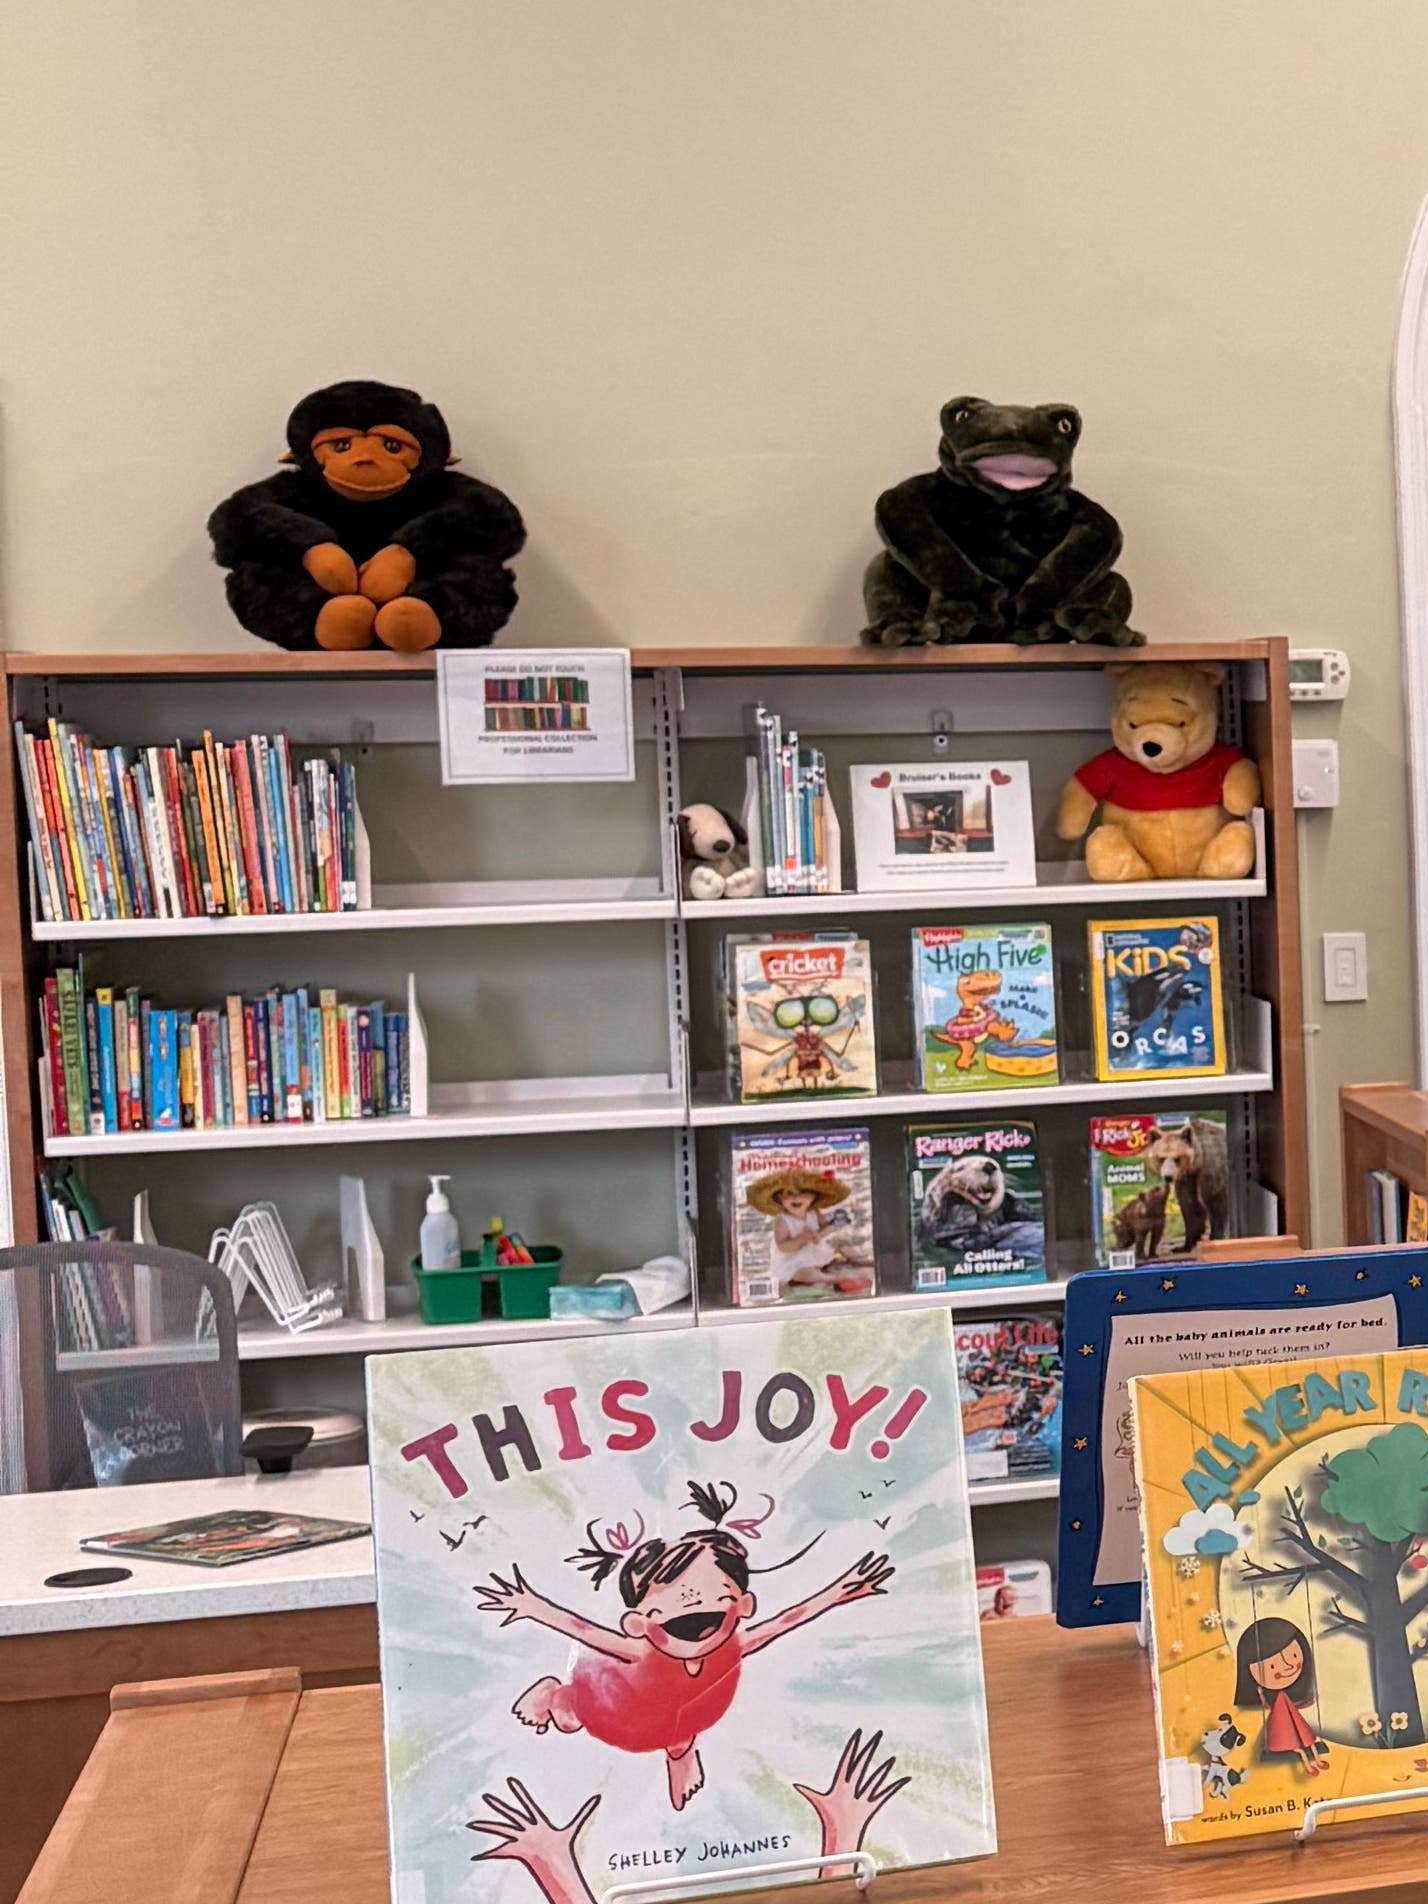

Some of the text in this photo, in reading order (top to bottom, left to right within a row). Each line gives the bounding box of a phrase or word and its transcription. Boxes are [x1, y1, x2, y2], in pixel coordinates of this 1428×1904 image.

[767, 953, 837, 973] cricket
[925, 940, 1044, 974] High Five
[1111, 1025, 1206, 1056] ORCAS
[914, 1134, 983, 1158] Ranger
[1107, 1172, 1145, 1183] MOMS
[953, 1260, 1025, 1275] All Otters!
[963, 1249, 1013, 1263] Calling
[1125, 1316, 1388, 1345] All the baby animals are ready for bed.
[400, 1369, 928, 1499] THIS JOY!
[1180, 1430, 1260, 1510] ALL
[1243, 1371, 1376, 1446] YEAR
[1245, 1804, 1283, 1818] Susan
[1286, 1801, 1301, 1813] B.
[608, 1834, 792, 1870] SHELLEY JOHANNES
